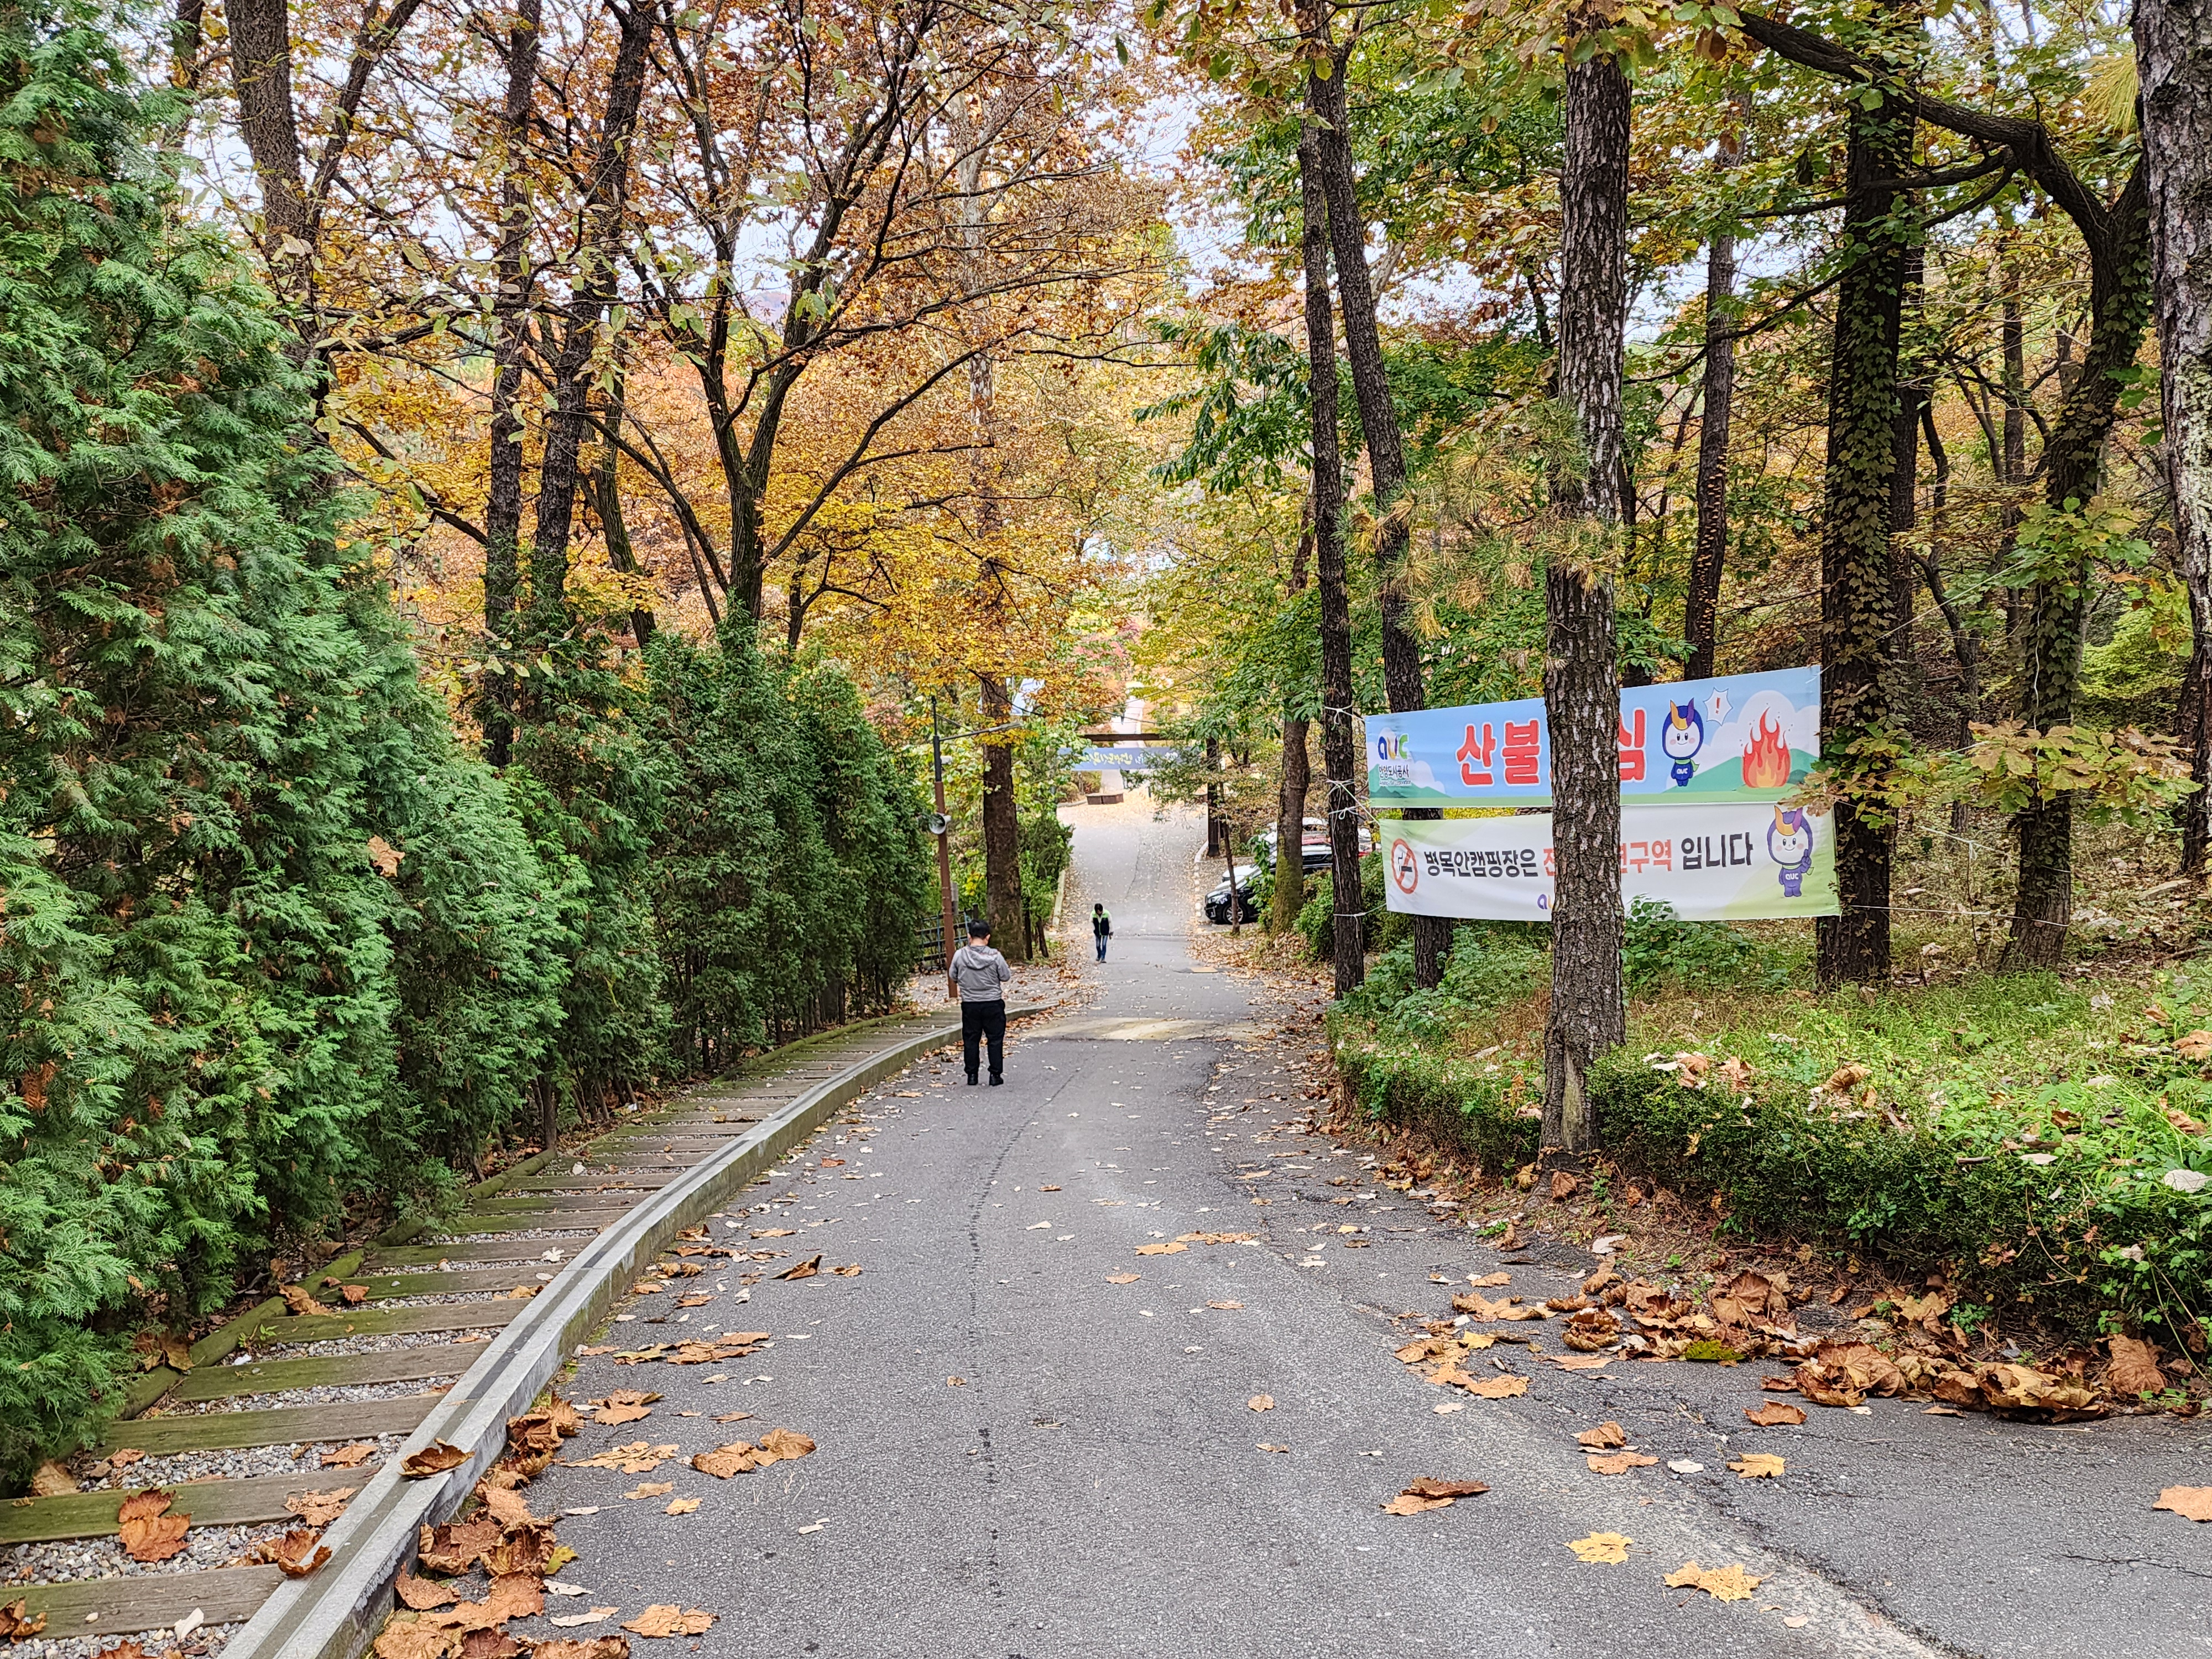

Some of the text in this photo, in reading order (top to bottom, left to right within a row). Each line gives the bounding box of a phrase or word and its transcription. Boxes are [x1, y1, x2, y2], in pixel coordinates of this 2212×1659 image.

[1456, 709, 1645, 785] 산불심
[1379, 764, 1409, 778] 안양도시공사
[1424, 849, 1538, 878] 병목안캠핑장은
[1681, 832, 1754, 870] 입니다
